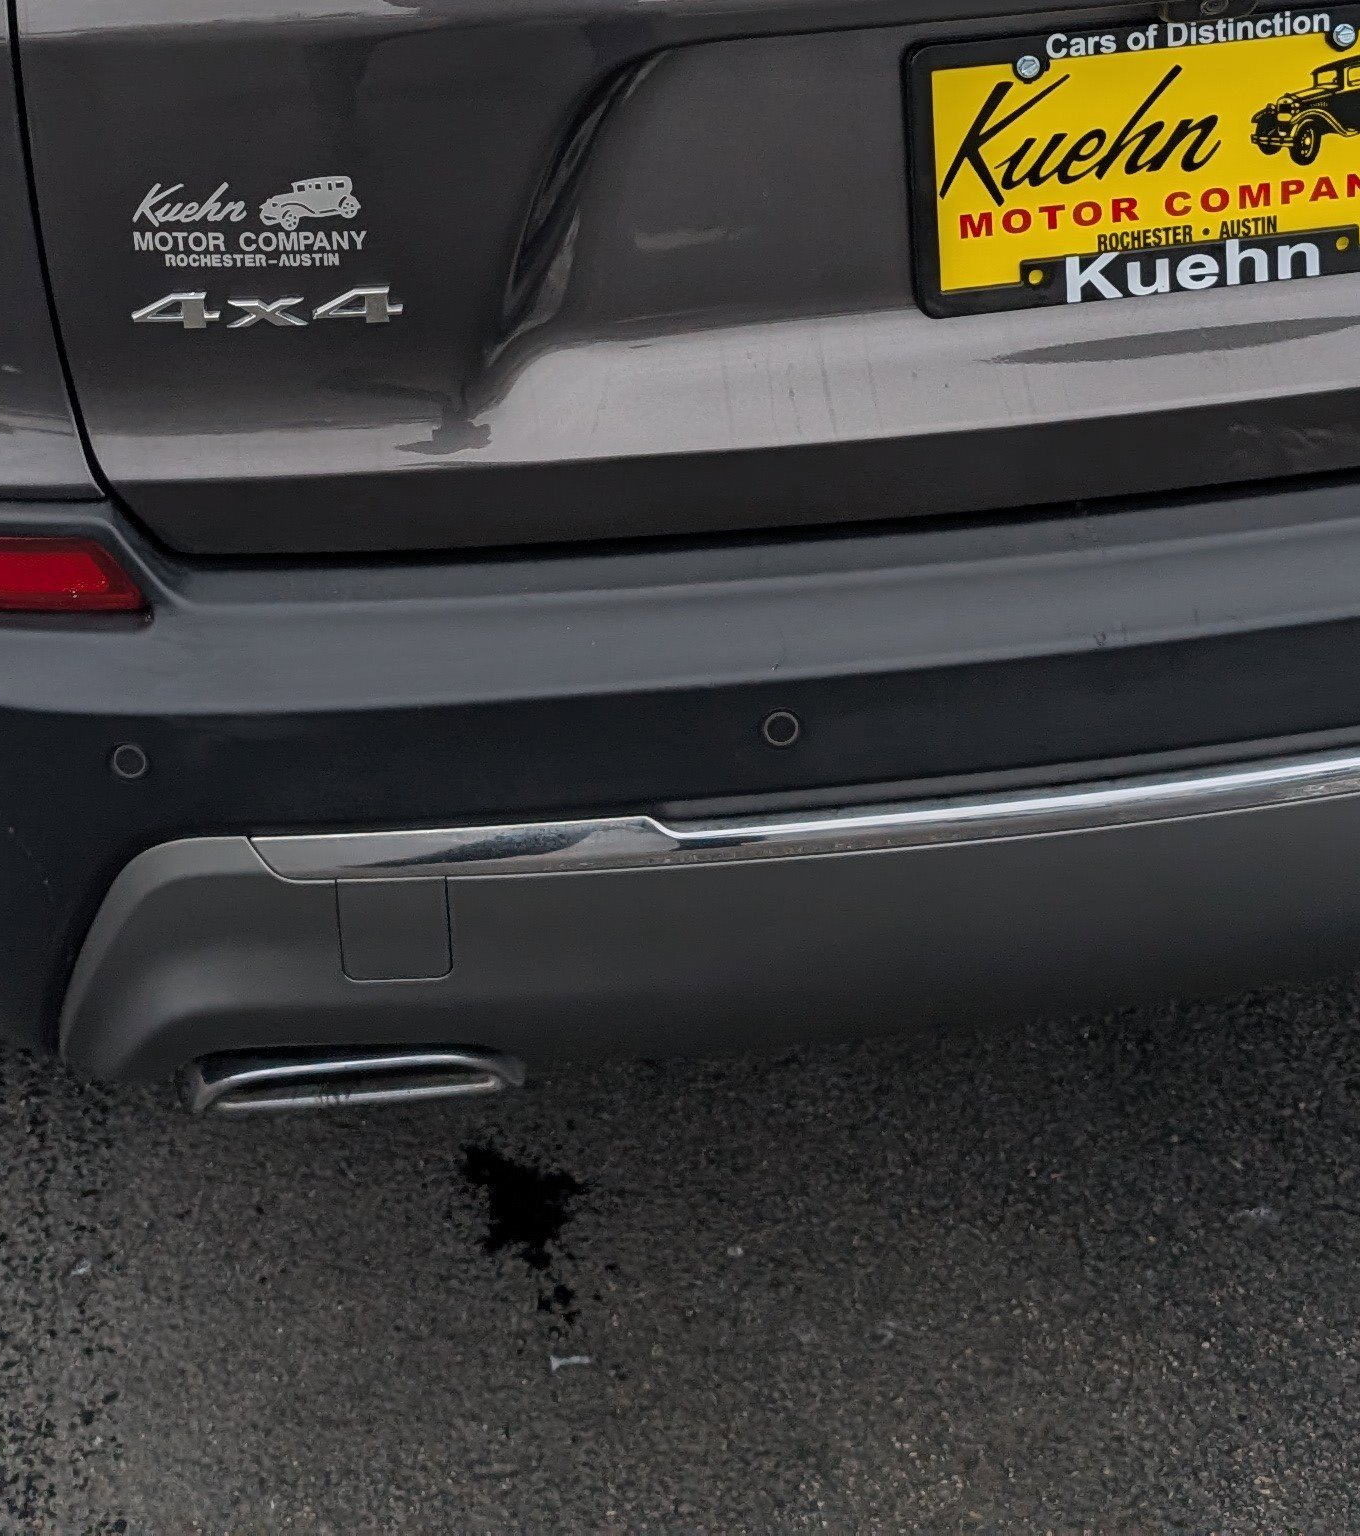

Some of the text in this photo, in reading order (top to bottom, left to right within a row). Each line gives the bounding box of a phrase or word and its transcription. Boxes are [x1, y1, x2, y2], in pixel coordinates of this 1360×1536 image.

[1045, 11, 1330, 59] Cars of Distinction
[939, 64, 1221, 206] Kuehn
[132, 182, 246, 227] Kuehn
[959, 196, 1140, 240] MOTOR
[133, 231, 366, 251] MOTOR COMPANY
[1097, 215, 1278, 252] ROCHESTER AUSTIN
[1065, 239, 1321, 304] Kuehn
